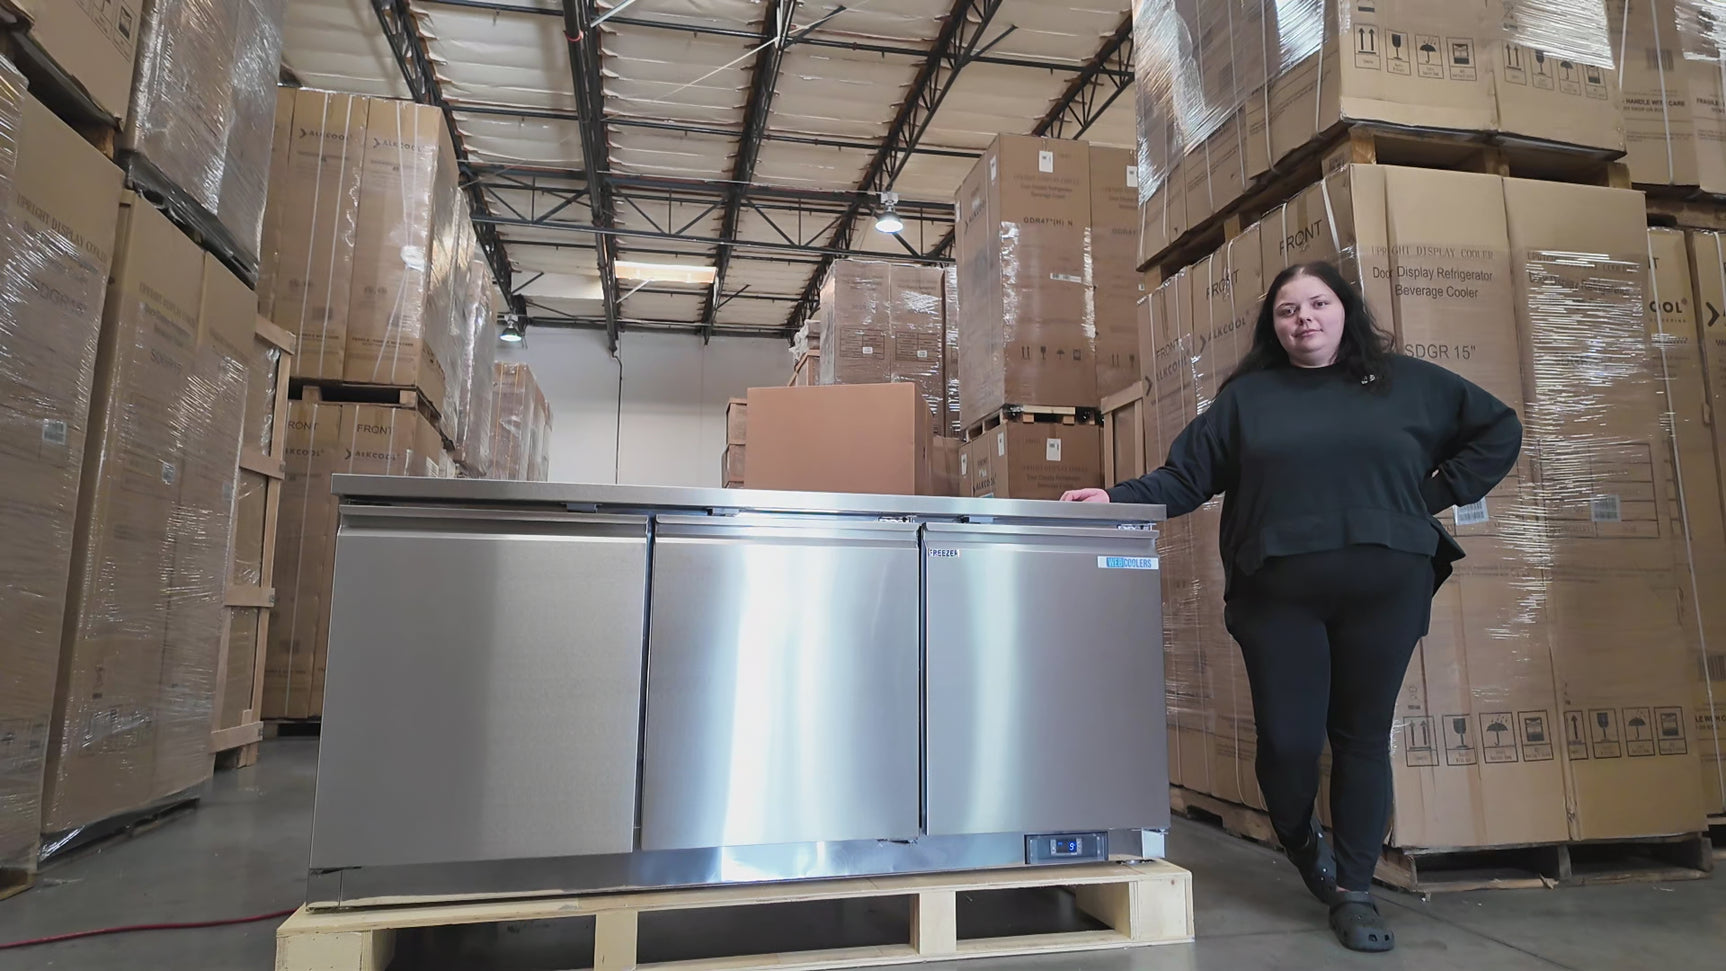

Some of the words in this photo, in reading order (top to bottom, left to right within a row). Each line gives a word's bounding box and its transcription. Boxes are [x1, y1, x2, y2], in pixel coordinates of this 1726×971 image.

[1280, 219, 1322, 256] FRONT
[1416, 247, 1456, 259] DISPLAY
[1372, 266, 1393, 280] Door
[1396, 265, 1434, 281] Display
[1436, 266, 1494, 283] Refrigerator
[1394, 284, 1444, 300] Beverage
[1446, 285, 1479, 299] Cooler
[1404, 343, 1451, 359] SDGR
[287, 420, 319, 431] RONT
